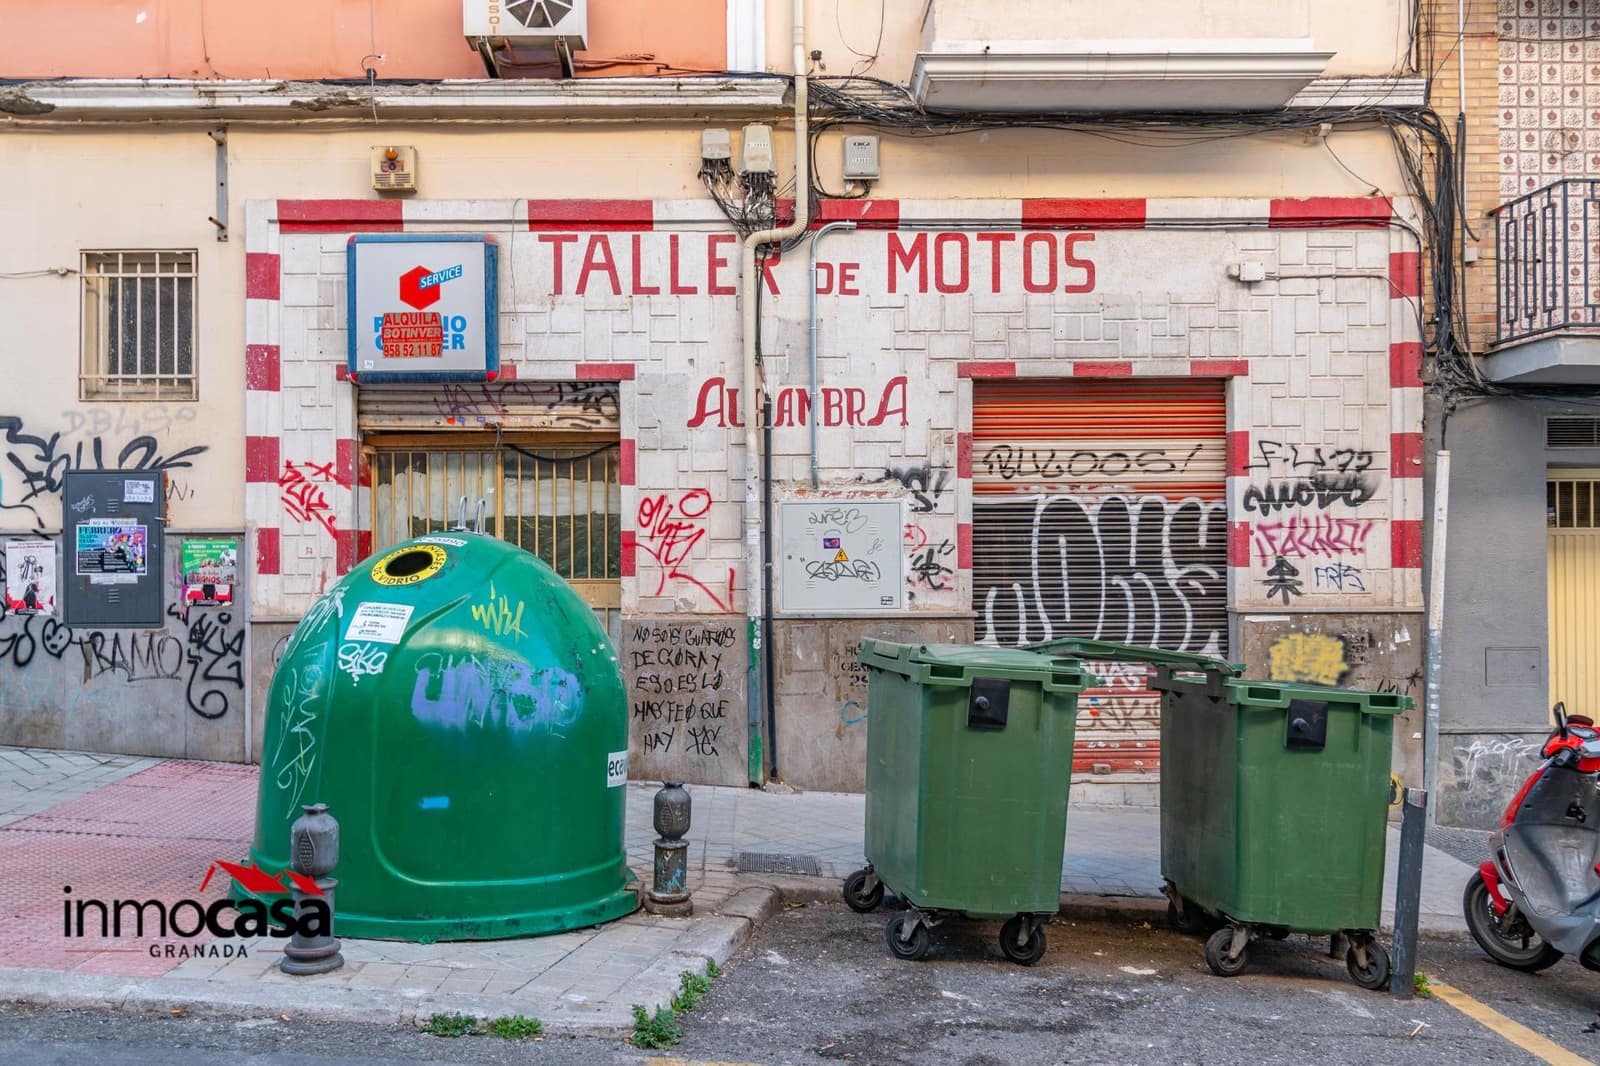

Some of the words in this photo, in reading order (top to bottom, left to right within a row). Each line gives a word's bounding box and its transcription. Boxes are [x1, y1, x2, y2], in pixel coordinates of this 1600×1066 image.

[538, 234, 781, 295] TALLER
[816, 262, 860, 296] DE
[887, 232, 1096, 294] MOTOS
[420, 265, 462, 289] SERVICE
[384, 312, 439, 326] ALQUILA
[383, 327, 442, 339] BOTINVER
[383, 344, 401, 357] 958
[403, 344, 414, 357] 52
[417, 344, 428, 357] 11
[431, 343, 442, 357] 87
[378, 574, 420, 585] VIDRIO
[701, 700, 729, 720] QUE
[643, 727, 675, 756] HAY
